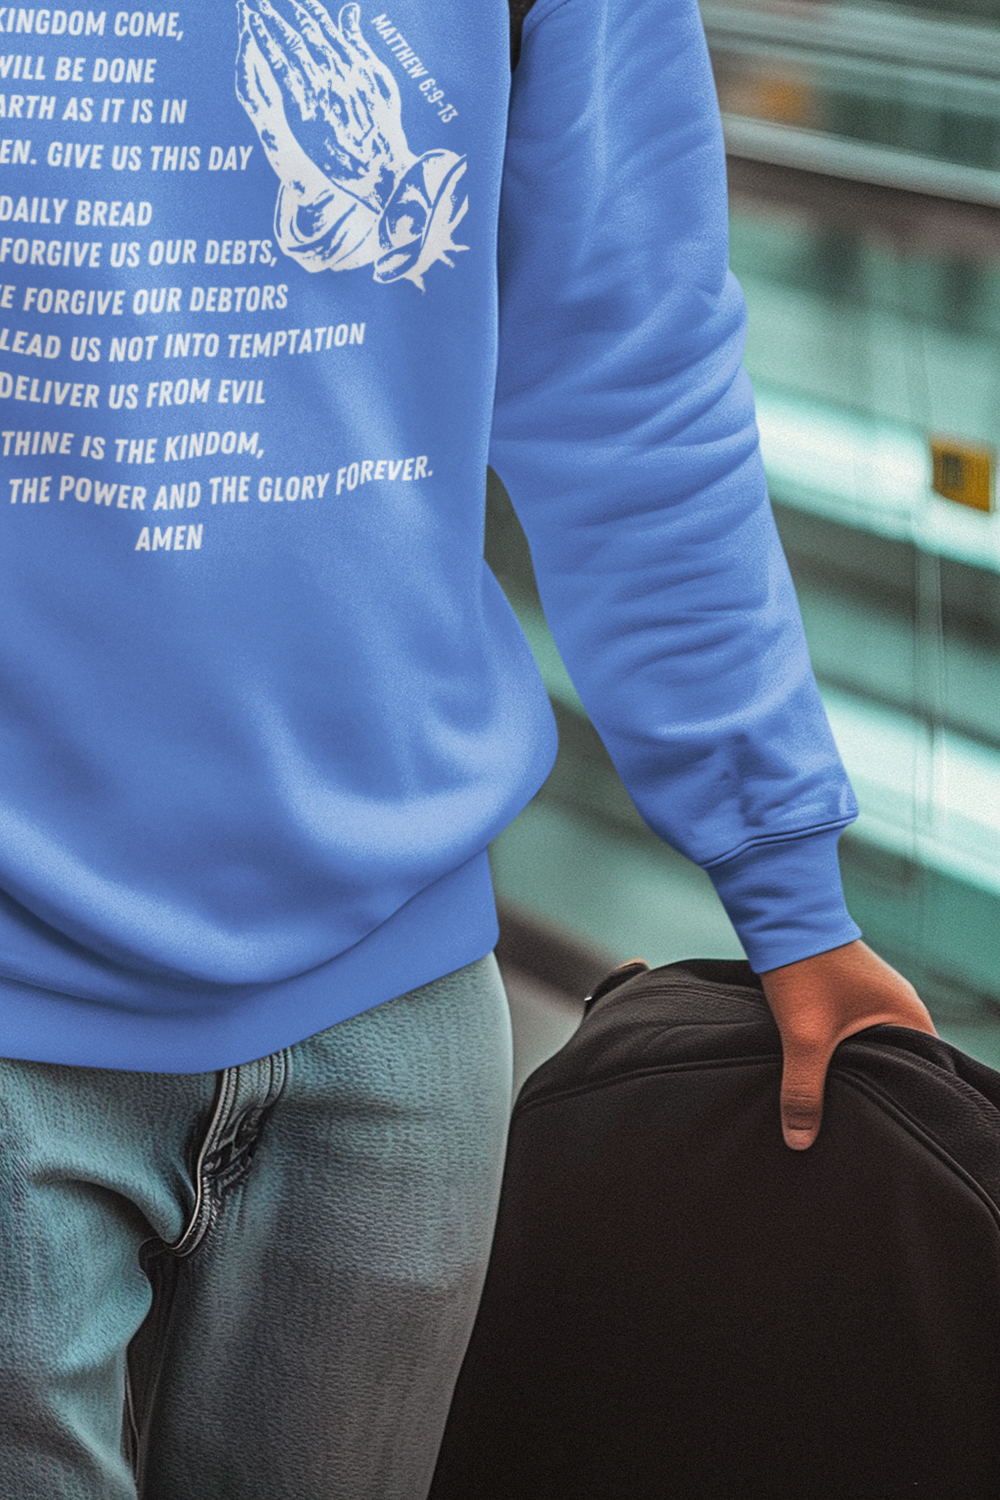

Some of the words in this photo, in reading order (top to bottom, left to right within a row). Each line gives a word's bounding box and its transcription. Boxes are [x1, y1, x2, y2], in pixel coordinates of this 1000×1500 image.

[114, 11, 184, 41] COME,
[54, 56, 86, 82] BE
[92, 57, 157, 84] DONE
[370, 13, 429, 79] MATTHEW
[419, 77, 459, 124] 6:9-13
[62, 97, 94, 123] AS
[101, 98, 125, 123] IT
[131, 98, 154, 124] IS
[160, 99, 187, 124] IN
[47, 141, 104, 170] GIVE
[111, 145, 142, 172] US
[150, 145, 201, 171] THIS
[208, 145, 253, 171] DAY
[75, 199, 153, 227] BREAD
[110, 241, 141, 268] US
[148, 239, 197, 266] OUR
[204, 239, 277, 267] DEBTS,
[22, 286, 126, 316] FORGIVE
[132, 287, 182, 316] OUR
[189, 283, 289, 313] DEBTORS
[70, 336, 102, 363] US
[108, 334, 159, 363] NOT
[164, 332, 220, 359] INTO
[228, 322, 366, 359] TEMPTATION
[108, 383, 139, 410] US
[145, 377, 211, 408] FROM
[217, 379, 265, 405] EVIL
[1, 430, 75, 457] THINE
[80, 435, 106, 461] IS
[114, 438, 158, 465] THE
[164, 430, 264, 463] KINDOM,
[9, 475, 53, 504] THE
[58, 474, 147, 511] POWER
[152, 480, 202, 511] AND
[209, 475, 251, 505] THE
[257, 472, 330, 503] GLORY
[335, 455, 433, 495] FOREVER.
[134, 523, 204, 552] AMEN
